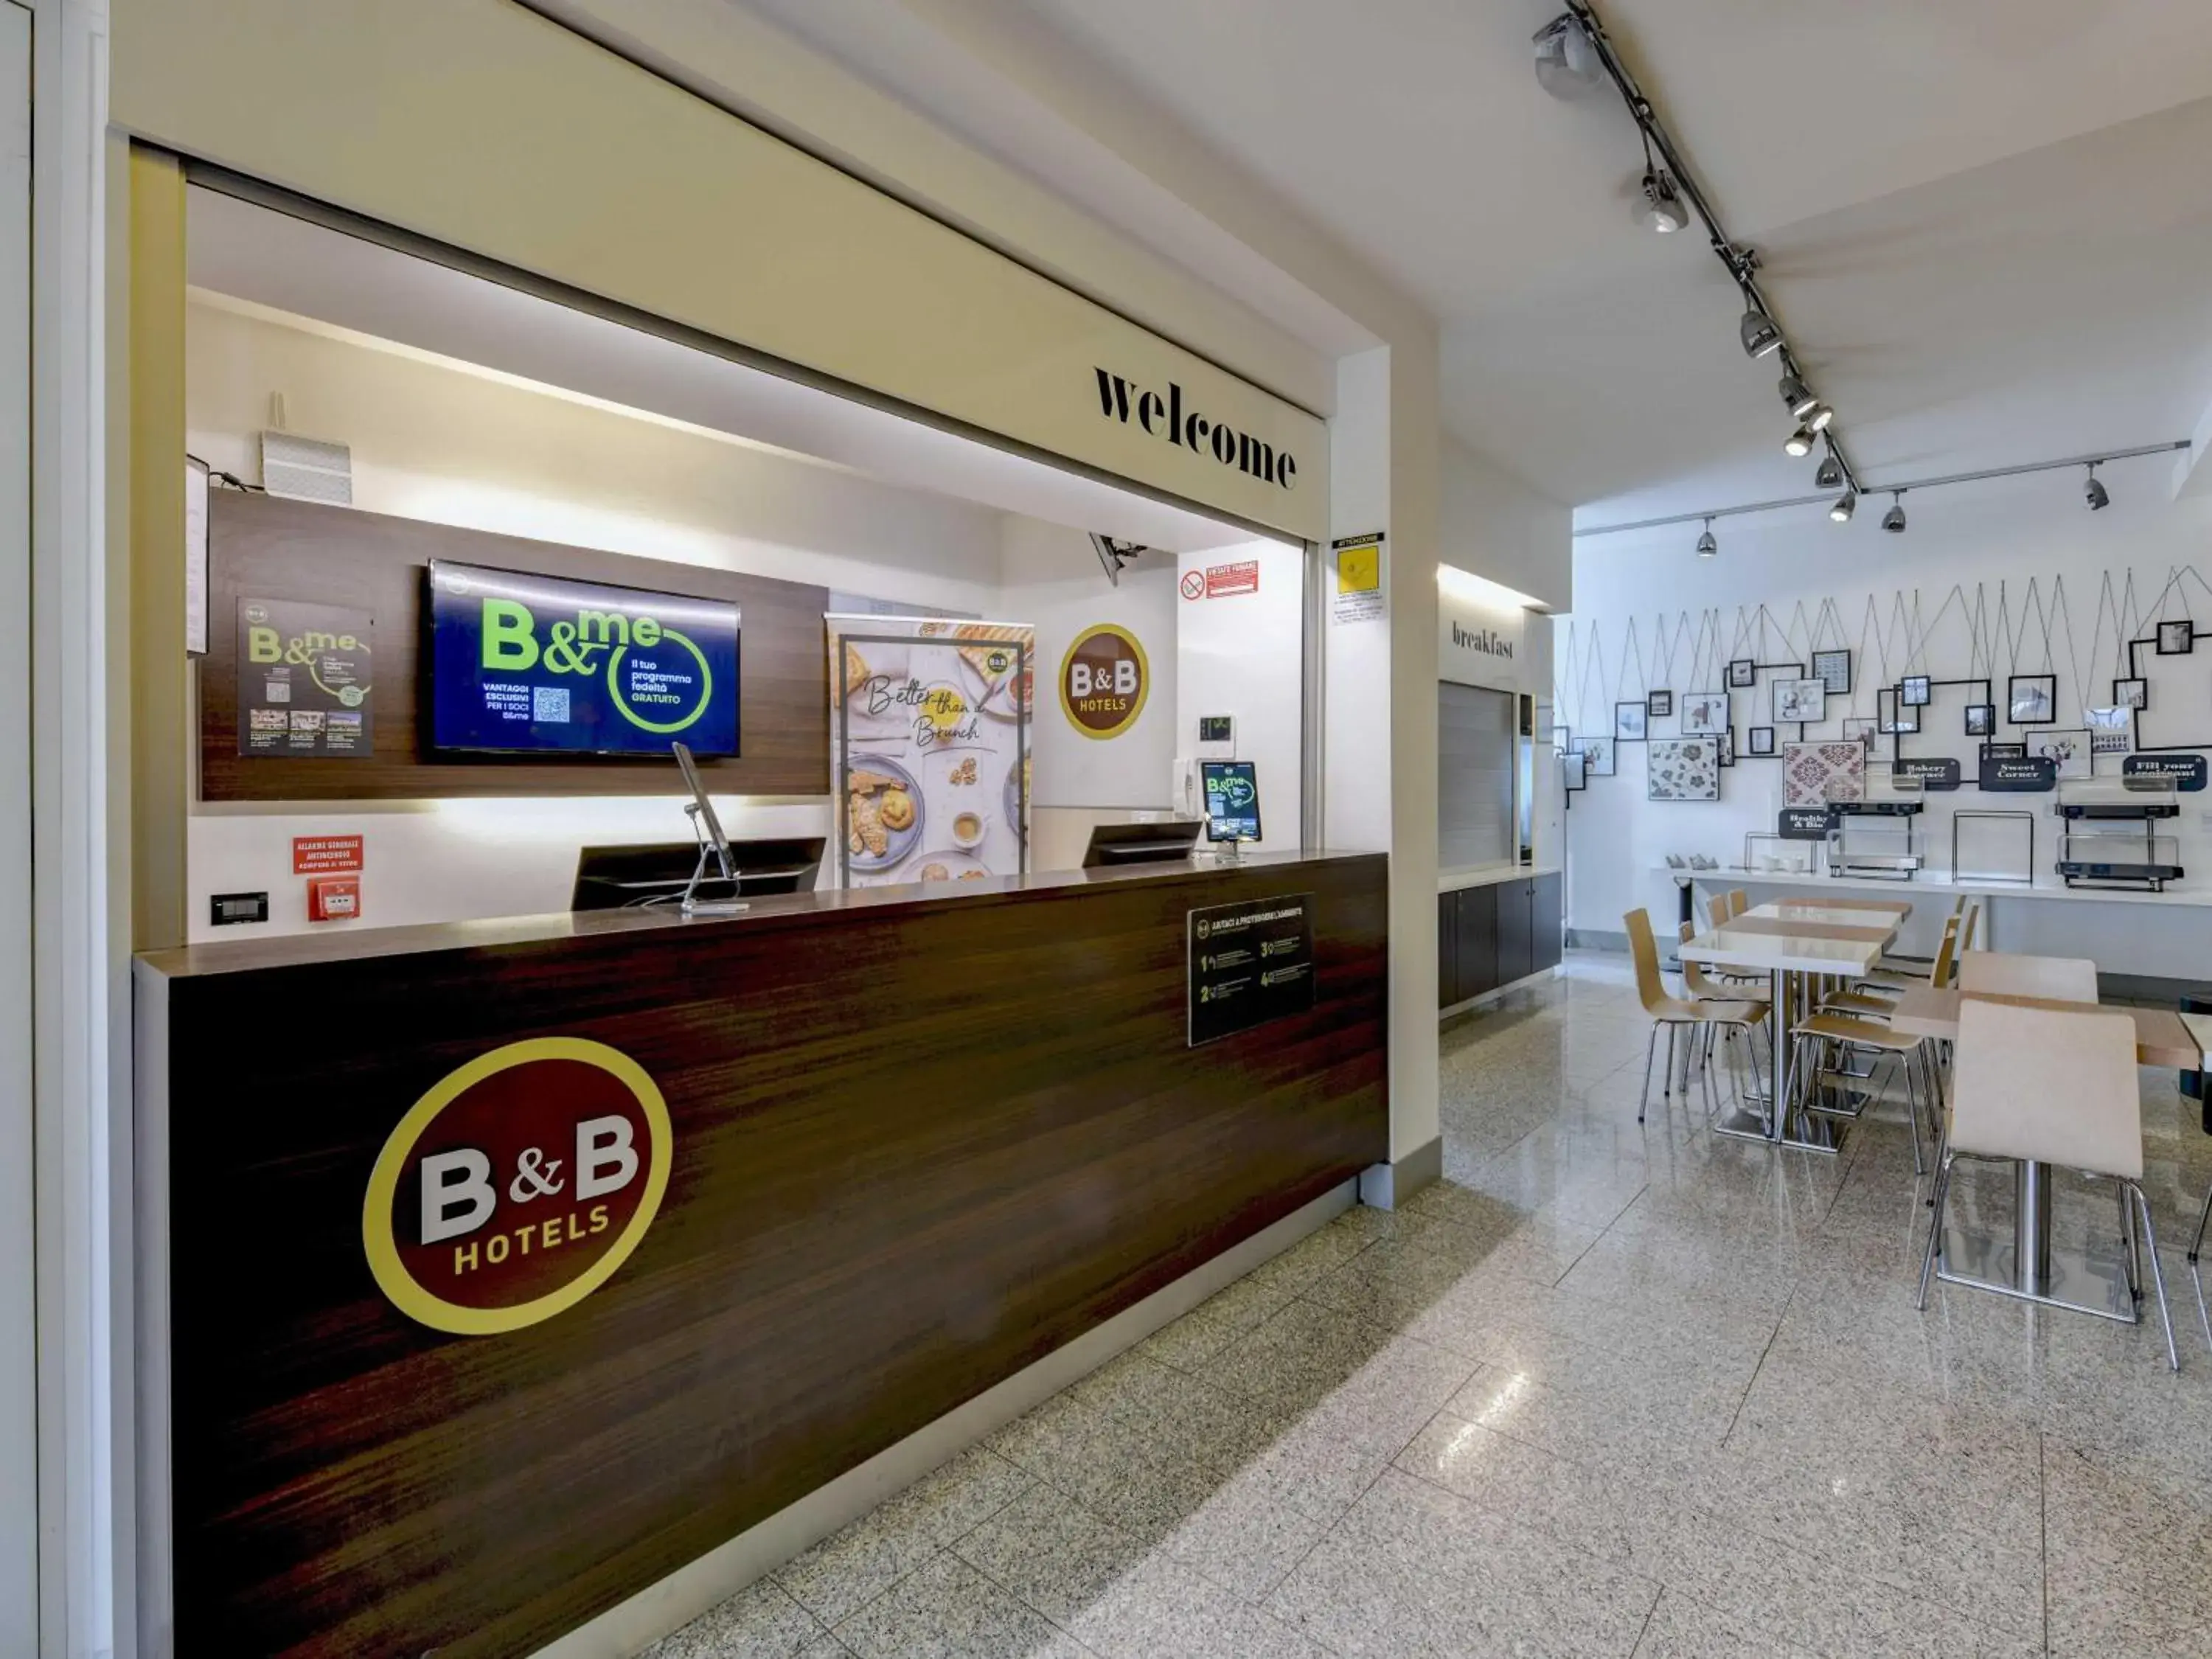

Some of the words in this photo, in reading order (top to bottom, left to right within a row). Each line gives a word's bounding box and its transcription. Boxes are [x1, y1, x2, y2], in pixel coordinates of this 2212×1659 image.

[1453, 620, 1513, 661] breakfast
[639, 660, 657, 670] tuo
[631, 672, 692, 684] programma
[483, 683, 529, 693] VANTAGGI
[863, 675, 934, 715] Better
[932, 691, 970, 714] than
[486, 692, 529, 702] ESCLUSIVI
[632, 693, 681, 704] GRATUITO
[1080, 698, 1126, 712] HOTELS
[913, 714, 980, 747] Brunch
[2136, 762, 2160, 770] Fill
[2163, 763, 2194, 772] your
[1997, 771, 2039, 779] Corner
[1261, 941, 1267, 958] 3
[1201, 956, 1207, 973] 1
[1200, 986, 1208, 1003] 2
[454, 1205, 610, 1276] HOTELS
